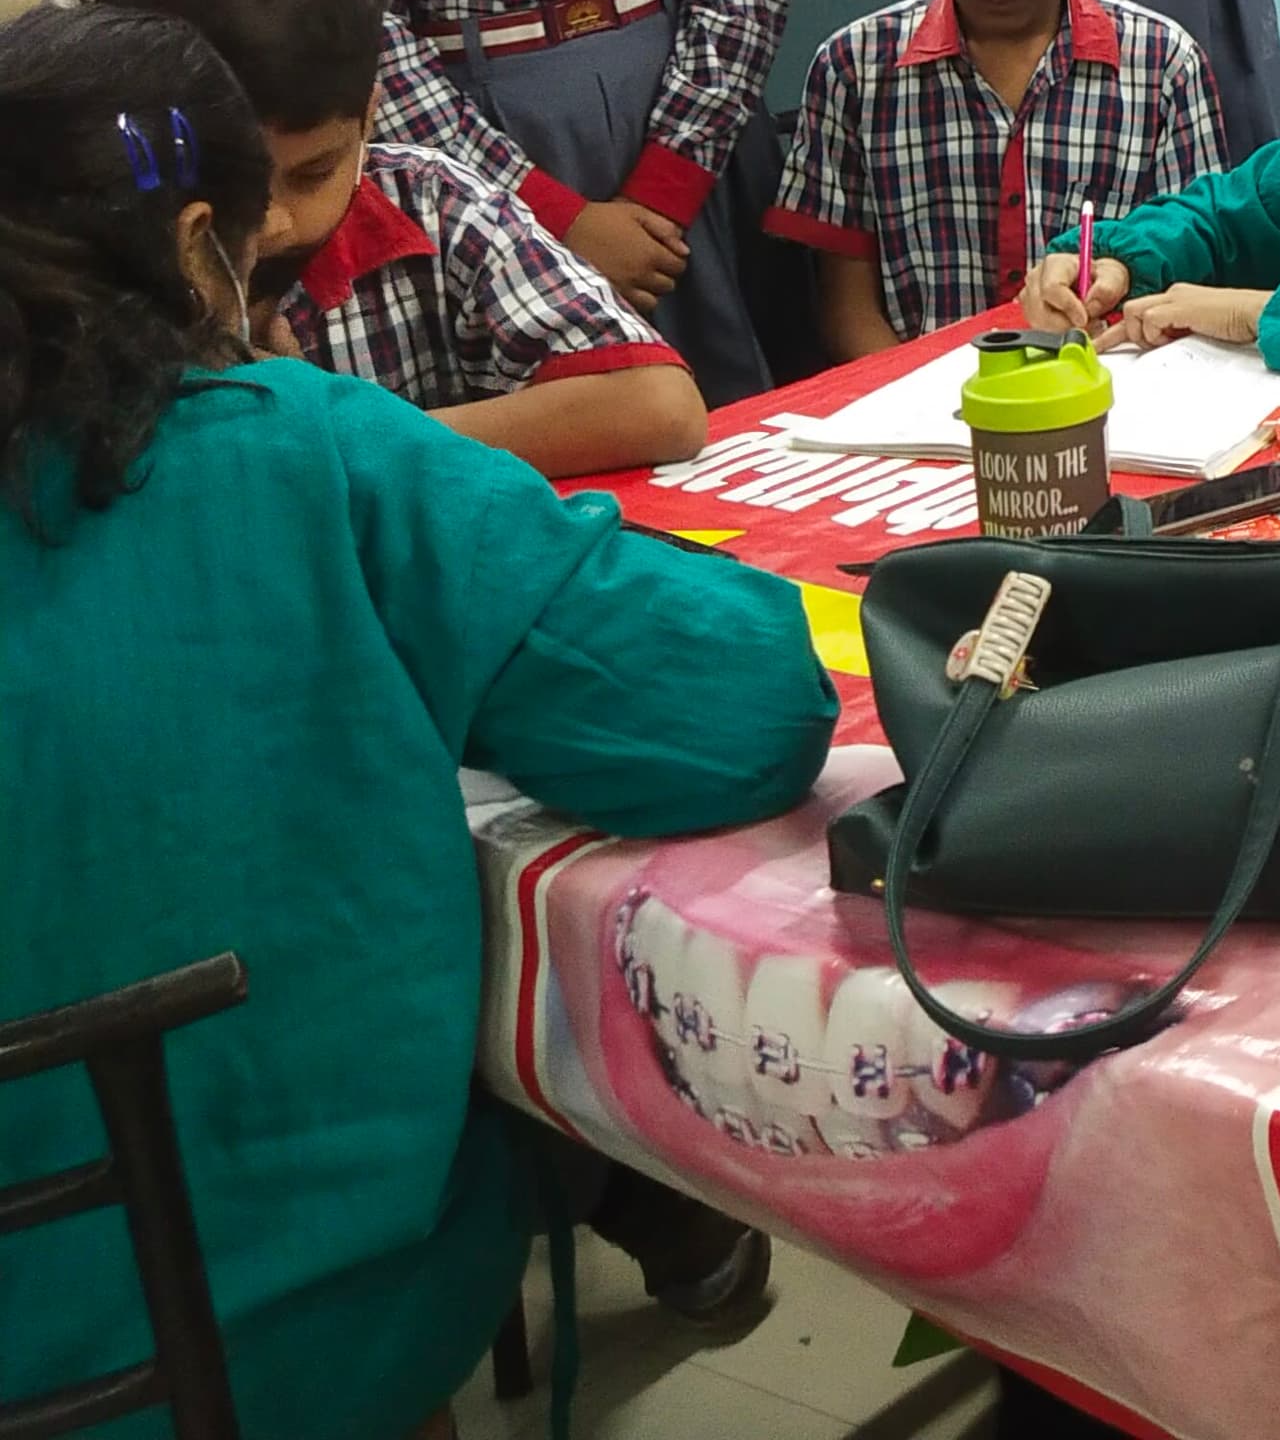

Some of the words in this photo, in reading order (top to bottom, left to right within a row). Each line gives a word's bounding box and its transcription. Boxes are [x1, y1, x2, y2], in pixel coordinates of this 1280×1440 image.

[979, 449, 1019, 483] LOOK
[1026, 453, 1047, 483] IN
[1054, 444, 1088, 479] THE
[988, 487, 1079, 519] MIRROR...
